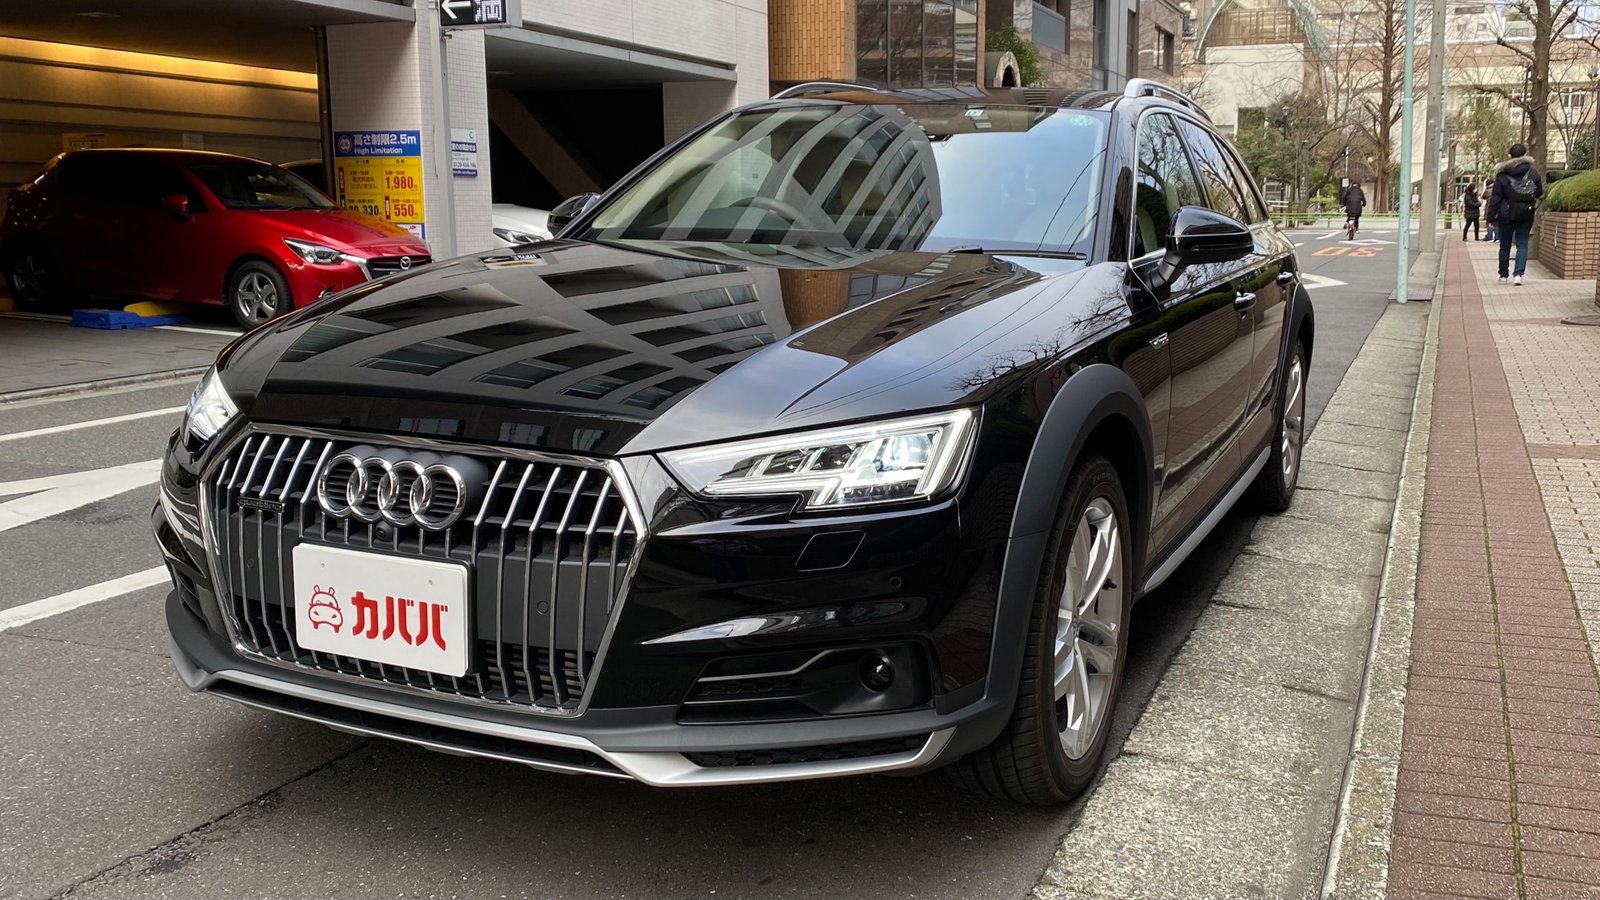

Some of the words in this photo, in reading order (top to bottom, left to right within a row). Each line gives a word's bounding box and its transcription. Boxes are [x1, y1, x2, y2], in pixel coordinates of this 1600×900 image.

[353, 133, 417, 145] 高さ制限2.5m
[354, 147, 370, 155] High
[351, 591, 448, 651] カババ
